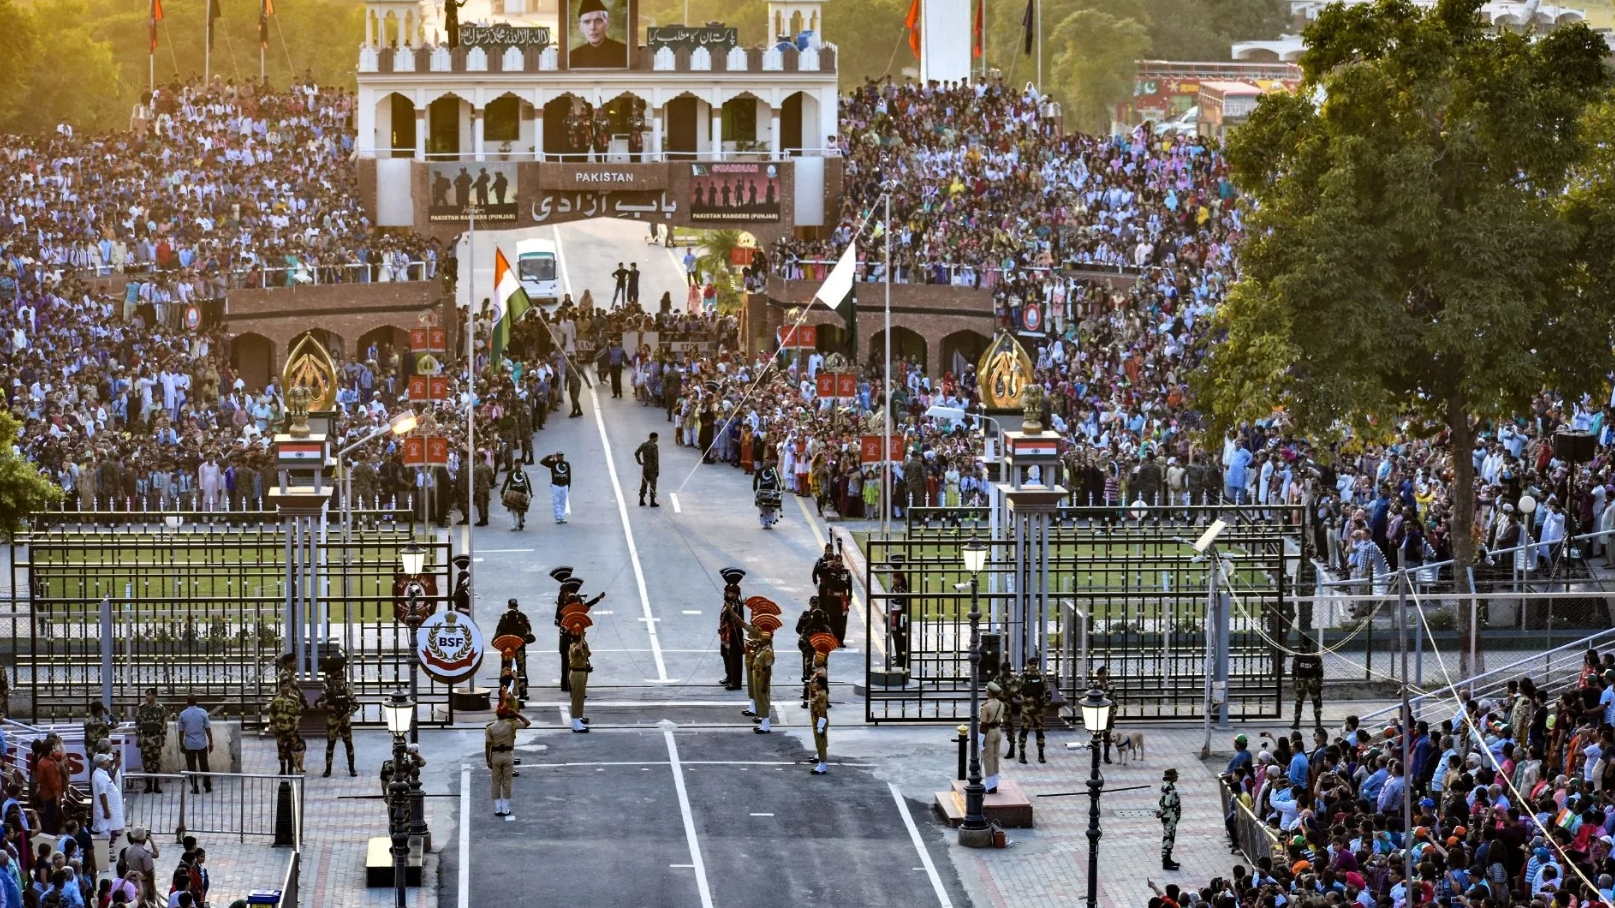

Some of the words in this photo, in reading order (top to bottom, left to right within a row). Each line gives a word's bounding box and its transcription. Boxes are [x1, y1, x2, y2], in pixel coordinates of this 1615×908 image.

[656, 30, 690, 45] مطلب
[690, 29, 700, 43] کا
[699, 29, 736, 45] پاکستان
[711, 164, 759, 173] GUARDIAN
[575, 172, 634, 182] PAKISTAN
[439, 637, 463, 647] BSF
